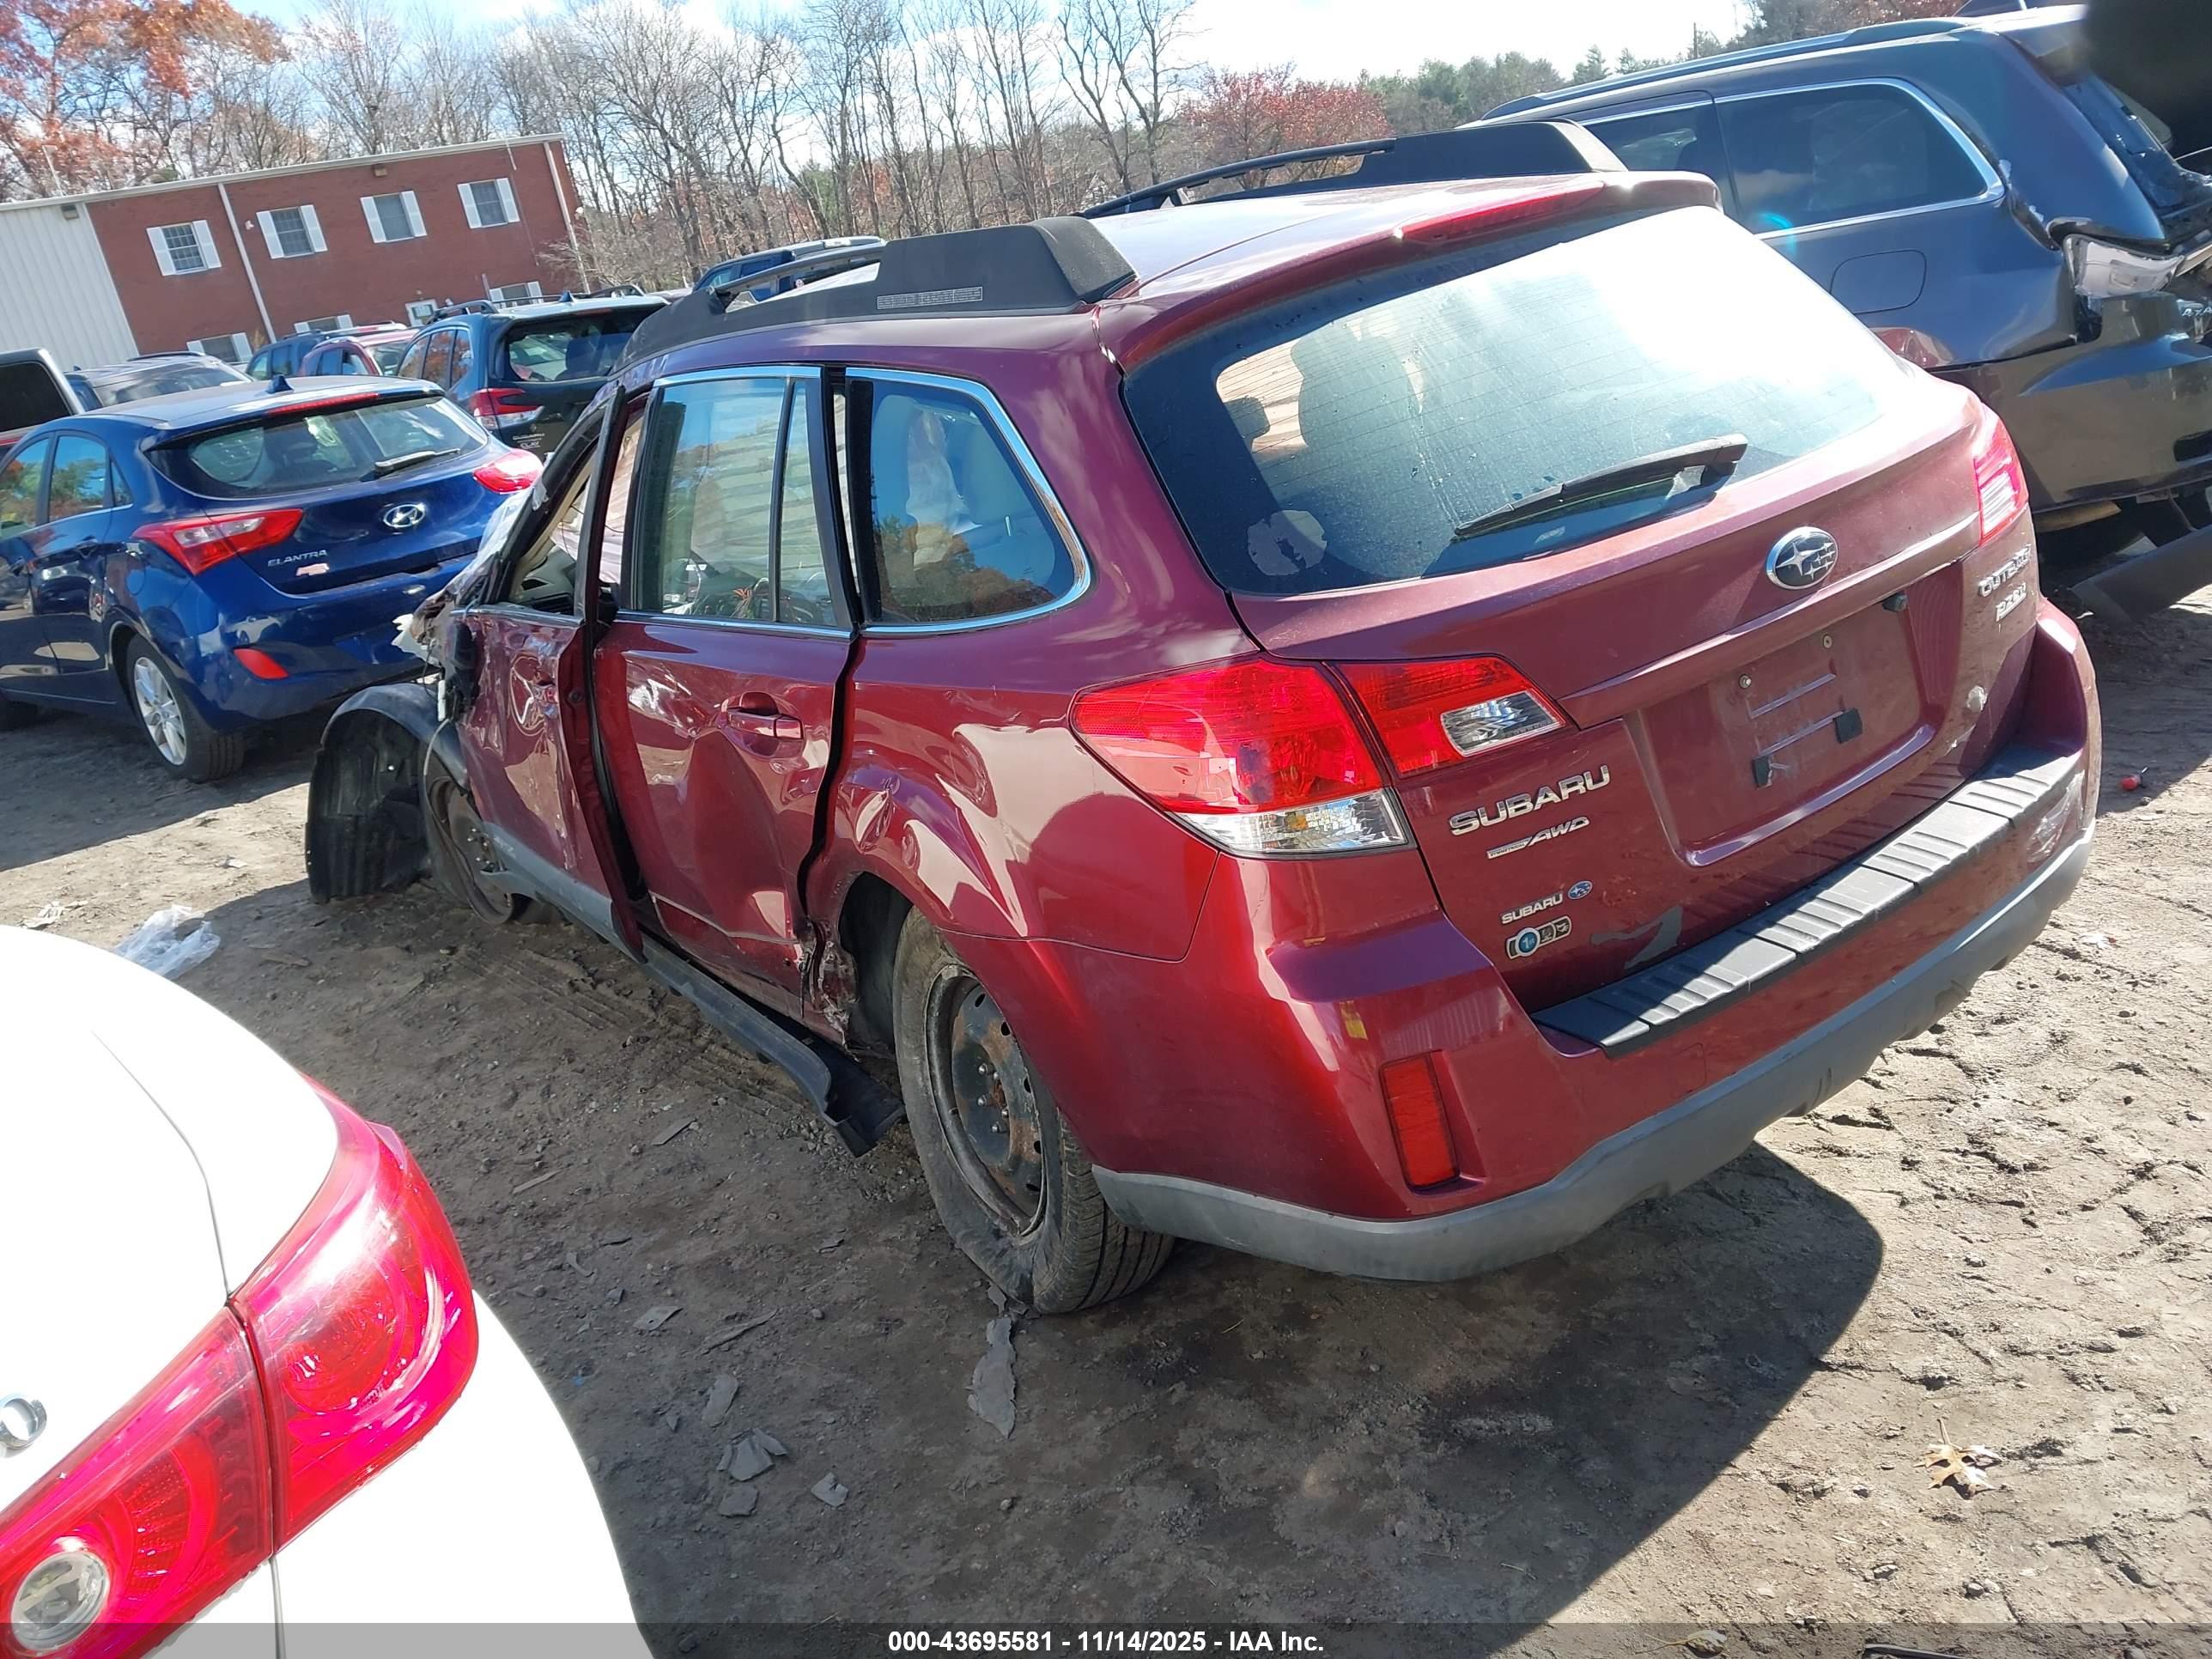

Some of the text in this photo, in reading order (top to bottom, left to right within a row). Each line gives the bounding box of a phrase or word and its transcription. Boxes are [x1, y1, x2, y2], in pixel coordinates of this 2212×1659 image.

[267, 549, 328, 567] ELANTRA
[1448, 764, 1612, 836] SUBARU
[1528, 816, 1590, 847] AWD
[1500, 891, 1564, 925] SUBARU
